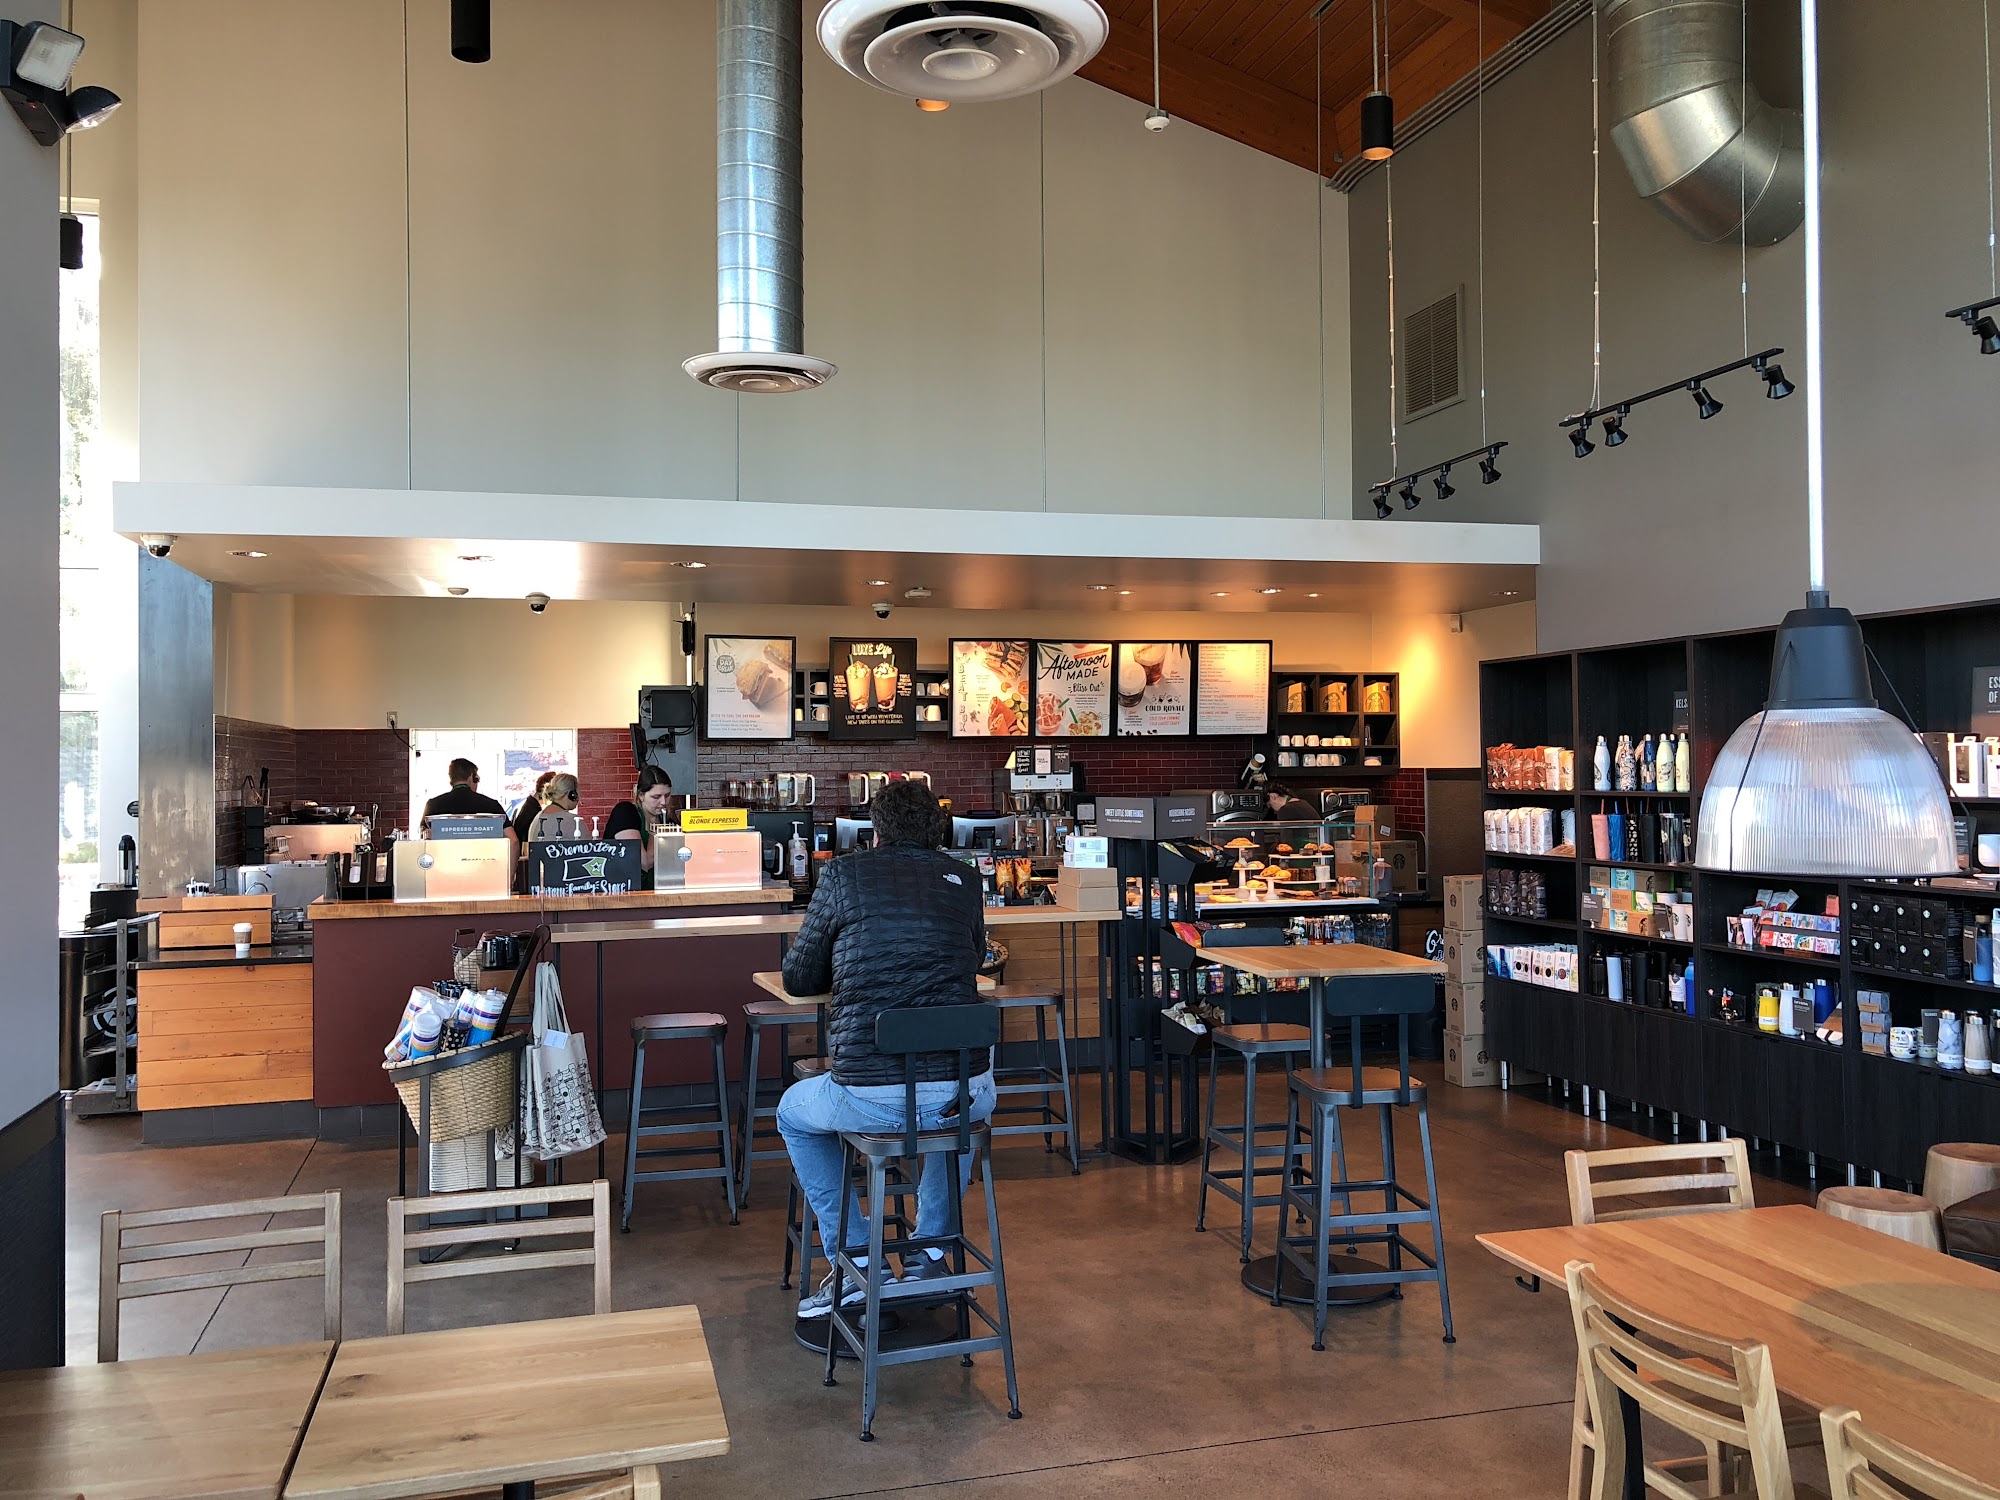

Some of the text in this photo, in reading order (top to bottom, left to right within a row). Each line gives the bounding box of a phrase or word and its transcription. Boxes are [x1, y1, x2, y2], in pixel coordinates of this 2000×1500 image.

[852, 643, 892, 658] LUXE Life
[1038, 654, 1110, 680] Afternoon
[1066, 666, 1099, 680] MADE
[1073, 683, 1101, 692] Bliss Out
[1988, 676, 2000, 689] ES
[1988, 691, 1998, 703] OF
[546, 842, 626, 858] Bremerton's
[568, 881, 596, 896] family
